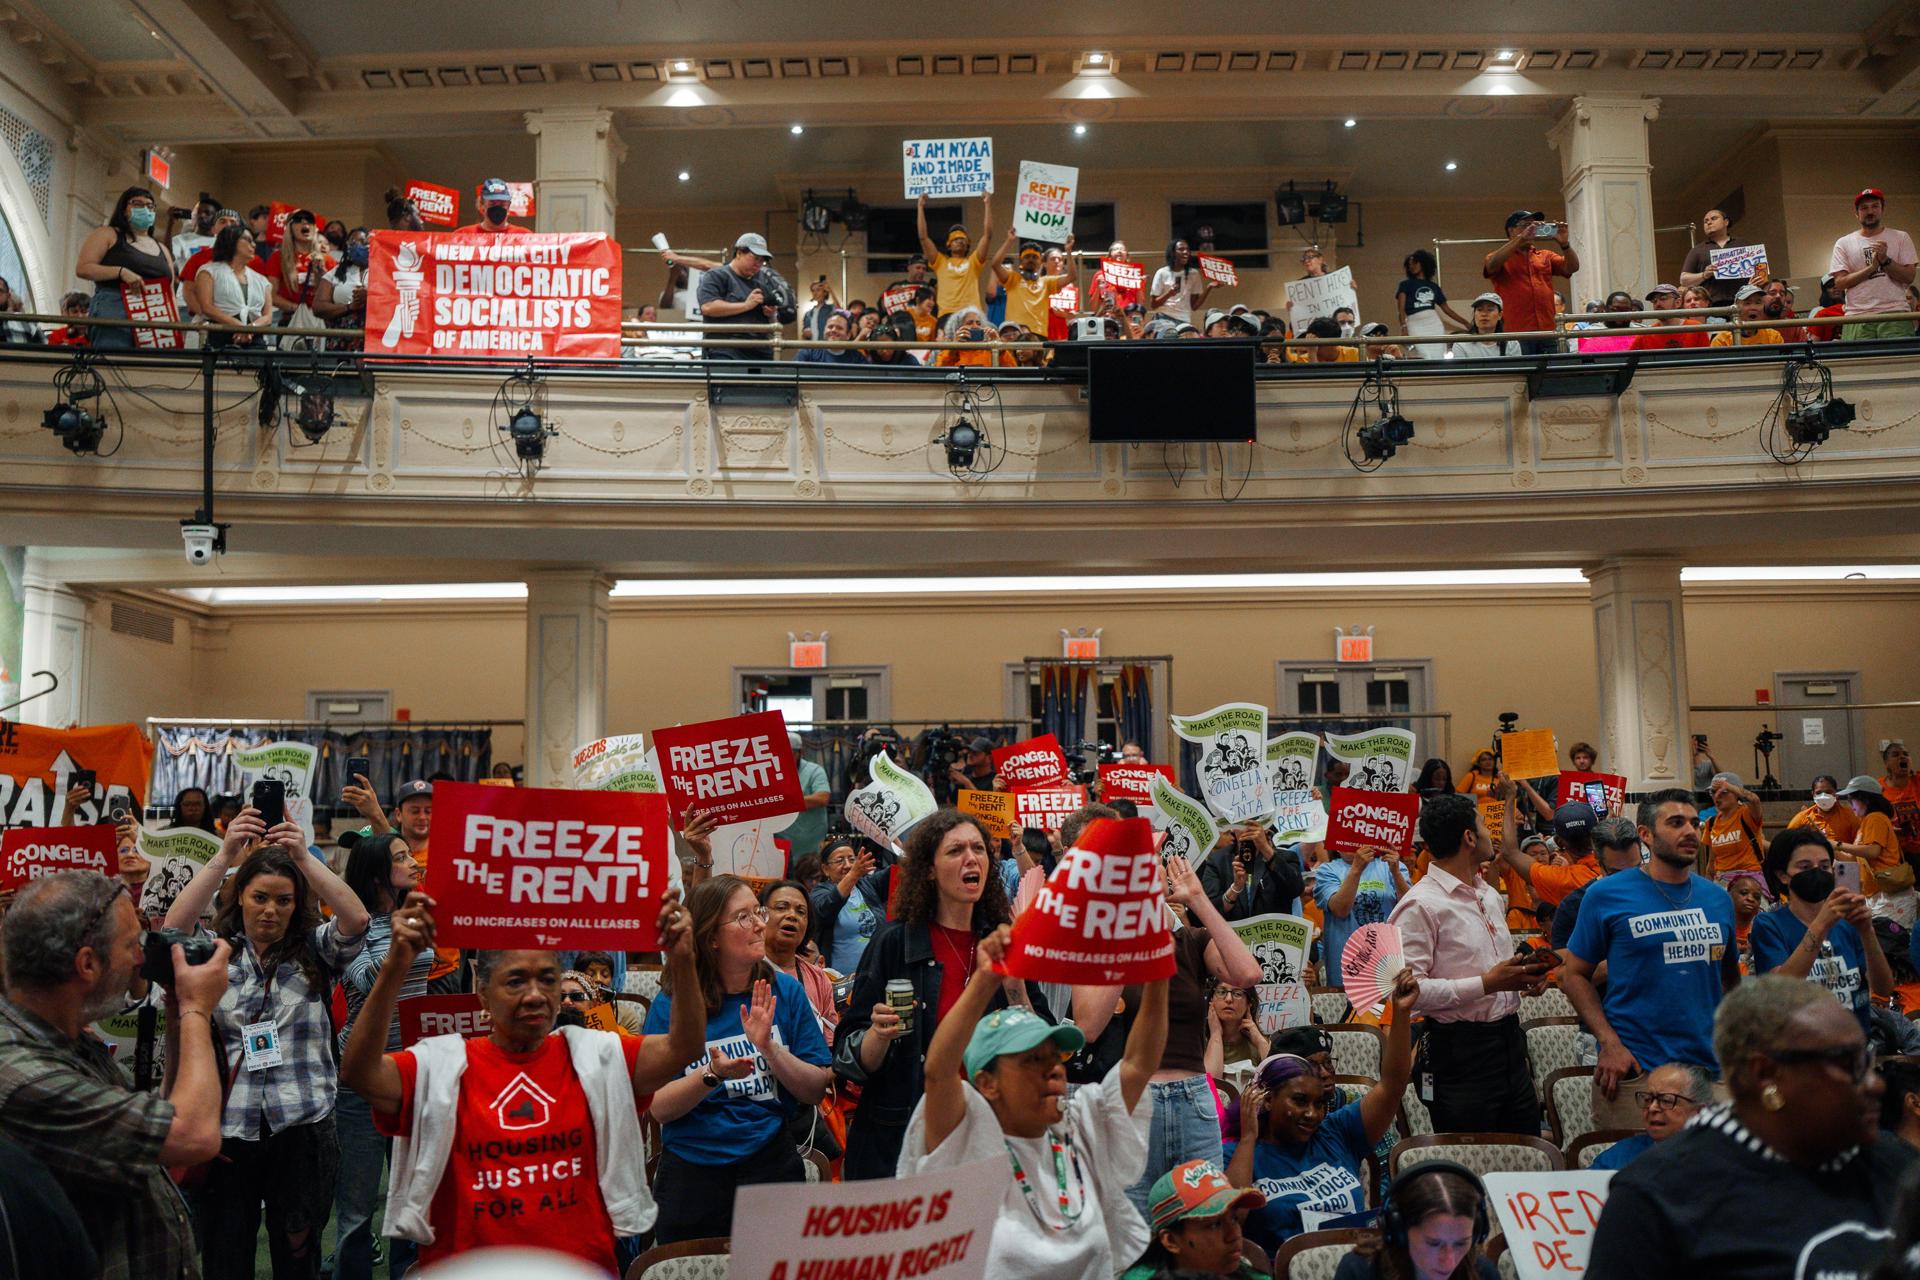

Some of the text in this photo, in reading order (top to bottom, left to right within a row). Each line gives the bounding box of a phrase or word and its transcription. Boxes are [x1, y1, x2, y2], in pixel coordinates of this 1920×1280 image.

[926, 143, 944, 158] AM
[949, 141, 990, 157] NYAA
[911, 159, 982, 176] AND I MADE
[932, 174, 975, 185] DOLLARS
[409, 187, 453, 205] FREEZE
[945, 184, 966, 194] LAST
[1029, 181, 1070, 200] RENT
[420, 200, 454, 215] RENT!
[1020, 193, 1073, 215] FREEZE
[1025, 209, 1065, 227] NOW
[435, 244, 571, 265] NEW YORK CITY
[1103, 261, 1142, 279] FREEZE
[1200, 257, 1234, 274] FREEZE
[435, 264, 610, 298] DEMOCRATIC
[1117, 276, 1142, 289] RENT
[1287, 278, 1322, 302] RENT
[434, 297, 591, 329] SOCIALISTS
[1307, 303, 1321, 314] IN
[433, 330, 543, 351] OF AMERICA
[1190, 712, 1261, 731] MAKE THE ROAD
[1223, 720, 1260, 729] NEW YORK
[670, 735, 774, 772] FREEZE
[1267, 746, 1280, 754] AKE
[1295, 740, 1315, 749] ROAD
[1299, 748, 1313, 756] YORK
[1340, 737, 1410, 752] MAKE THE ROAD
[1391, 746, 1409, 757] YORK
[243, 749, 310, 762] MAKE THE ROAD
[1000, 751, 1060, 777] ¡CONGELA
[671, 756, 784, 800] THE RENT!
[880, 764, 900, 783] MAKE
[1007, 762, 1061, 780] LA RENTA!
[1106, 768, 1156, 782] ¡CONGE
[612, 775, 630, 787] THE
[637, 782, 657, 790] YORK
[727, 794, 785, 811] ON ALL LEASES
[970, 793, 1005, 804] FREEZE
[979, 802, 1006, 812] RENT!
[1017, 793, 1082, 812] FREEZE
[1273, 791, 1313, 807] FREEZE
[1160, 791, 1211, 842] MAKE THE ROAD
[1281, 806, 1301, 816] THE
[1337, 803, 1410, 829] ¡CONGELA
[1019, 813, 1067, 829] THE RE
[1277, 811, 1311, 832] RENT
[464, 814, 644, 864] FREEZE
[1182, 816, 1206, 847] NEW YORK
[1342, 819, 1407, 845] LA RENTA!
[146, 837, 216, 854] MAKE THE ROAD
[7, 843, 108, 872] ¡CONGELA
[13, 867, 26, 878] LA
[452, 858, 650, 904] THE RENT!
[1035, 887, 1078, 928] THE
[453, 916, 640, 929] NO INCREASES ON ALL LEASES
[1239, 922, 1305, 937] KE THE ROAD
[1635, 913, 1702, 934] COMMUNITY
[1261, 932, 1302, 944] NEW YORK
[1680, 926, 1719, 942] VOICES
[1024, 944, 1150, 964] NO INCREASES ON ALL
[1669, 943, 1705, 960] HEARD
[1256, 986, 1300, 1003] REEZE
[1259, 1001, 1286, 1014] THE
[420, 1010, 491, 1035] FREE
[467, 1129, 583, 1162] HOUSING
[472, 1157, 582, 1191] JUSTICE
[1259, 1167, 1332, 1197] COMMUNITY
[1311, 1170, 1356, 1200] VOICES
[474, 1186, 577, 1219] FOR ALL
[803, 1190, 953, 1238] HOUSING IS
[769, 1229, 975, 1280] A HUMAN RIGHT!
[1533, 1240, 1584, 1271] DE
